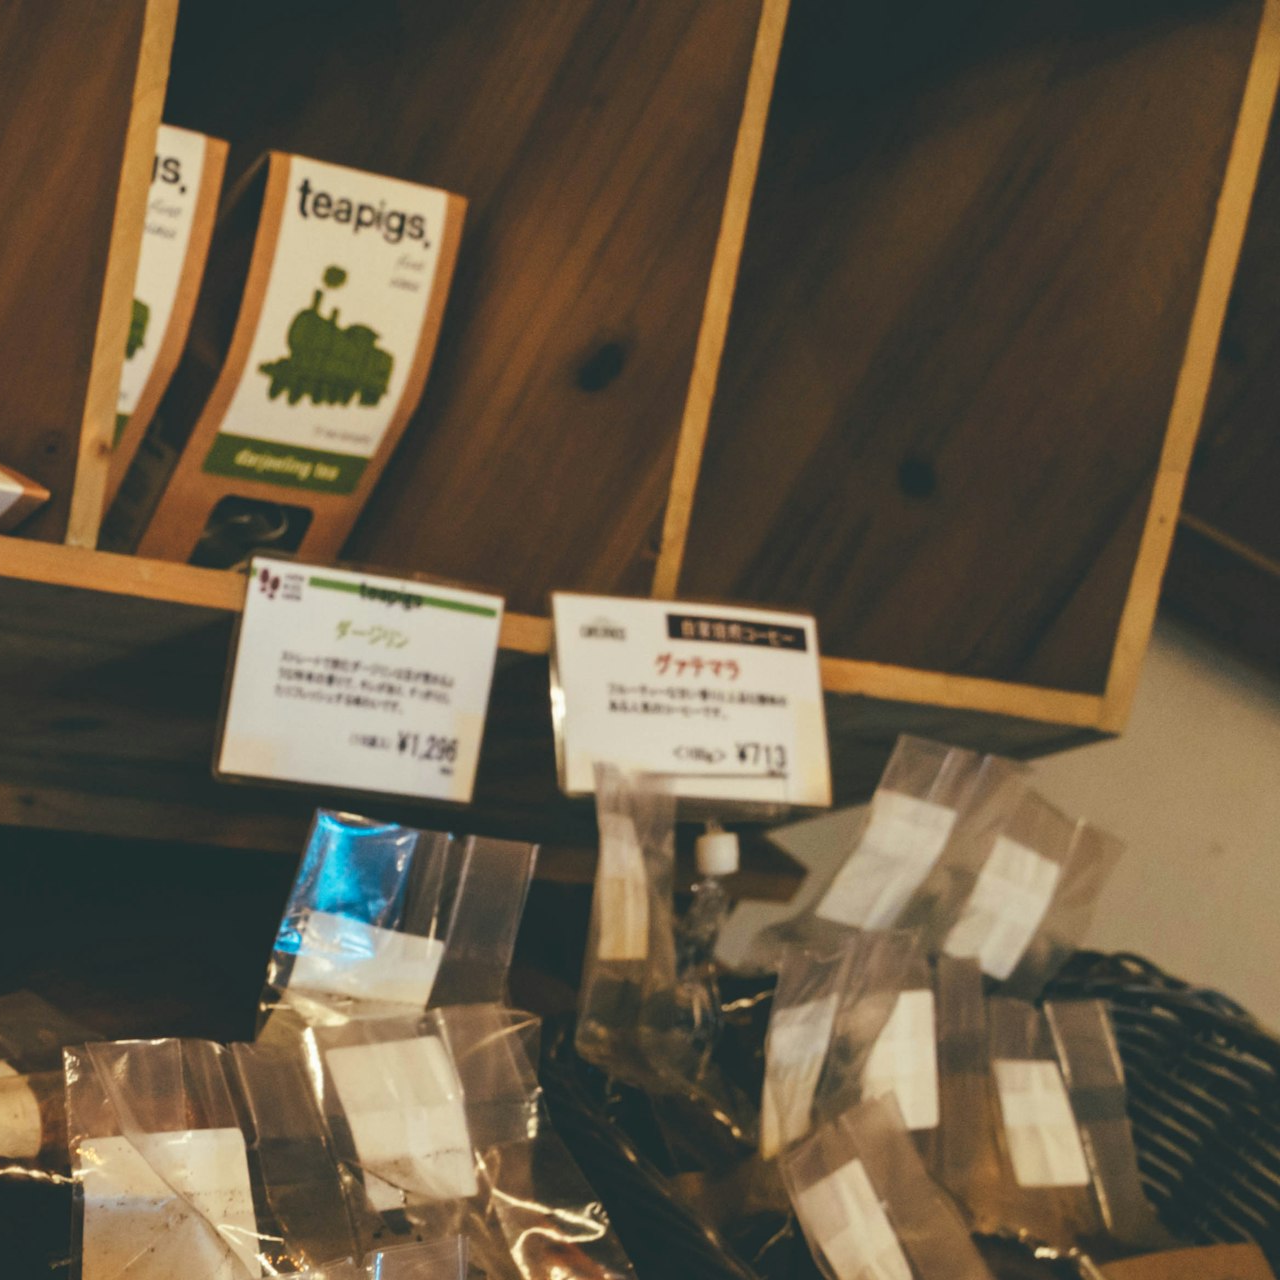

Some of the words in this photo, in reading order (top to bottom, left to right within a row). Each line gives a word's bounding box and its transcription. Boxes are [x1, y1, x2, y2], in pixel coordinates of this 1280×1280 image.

[297, 177, 432, 249] teapigs.
[335, 619, 409, 649] ダージリン
[654, 651, 742, 682] グァテマラ
